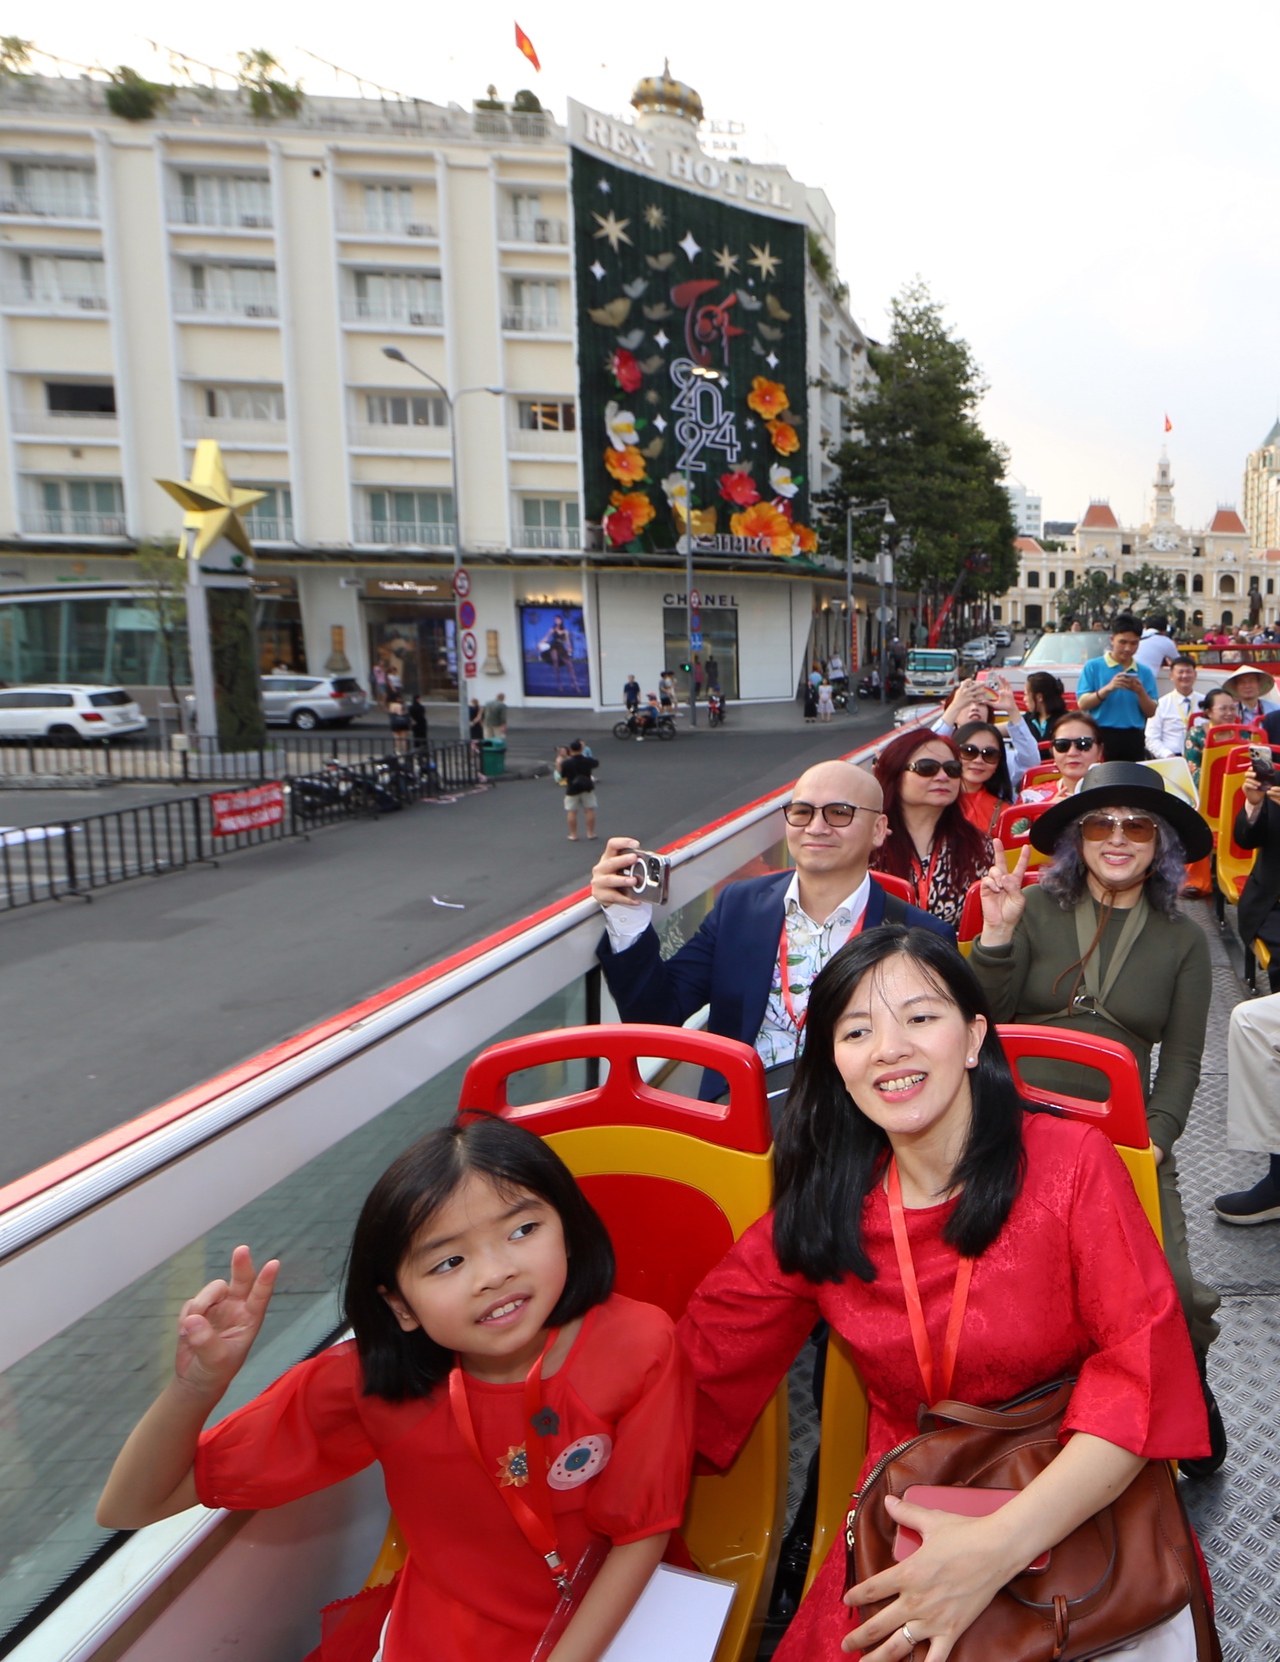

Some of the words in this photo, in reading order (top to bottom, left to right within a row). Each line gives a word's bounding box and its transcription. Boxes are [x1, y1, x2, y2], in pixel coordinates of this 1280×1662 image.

[584, 107, 655, 168] REX
[668, 151, 792, 210] HOTEL
[663, 593, 740, 607] CHNEL
